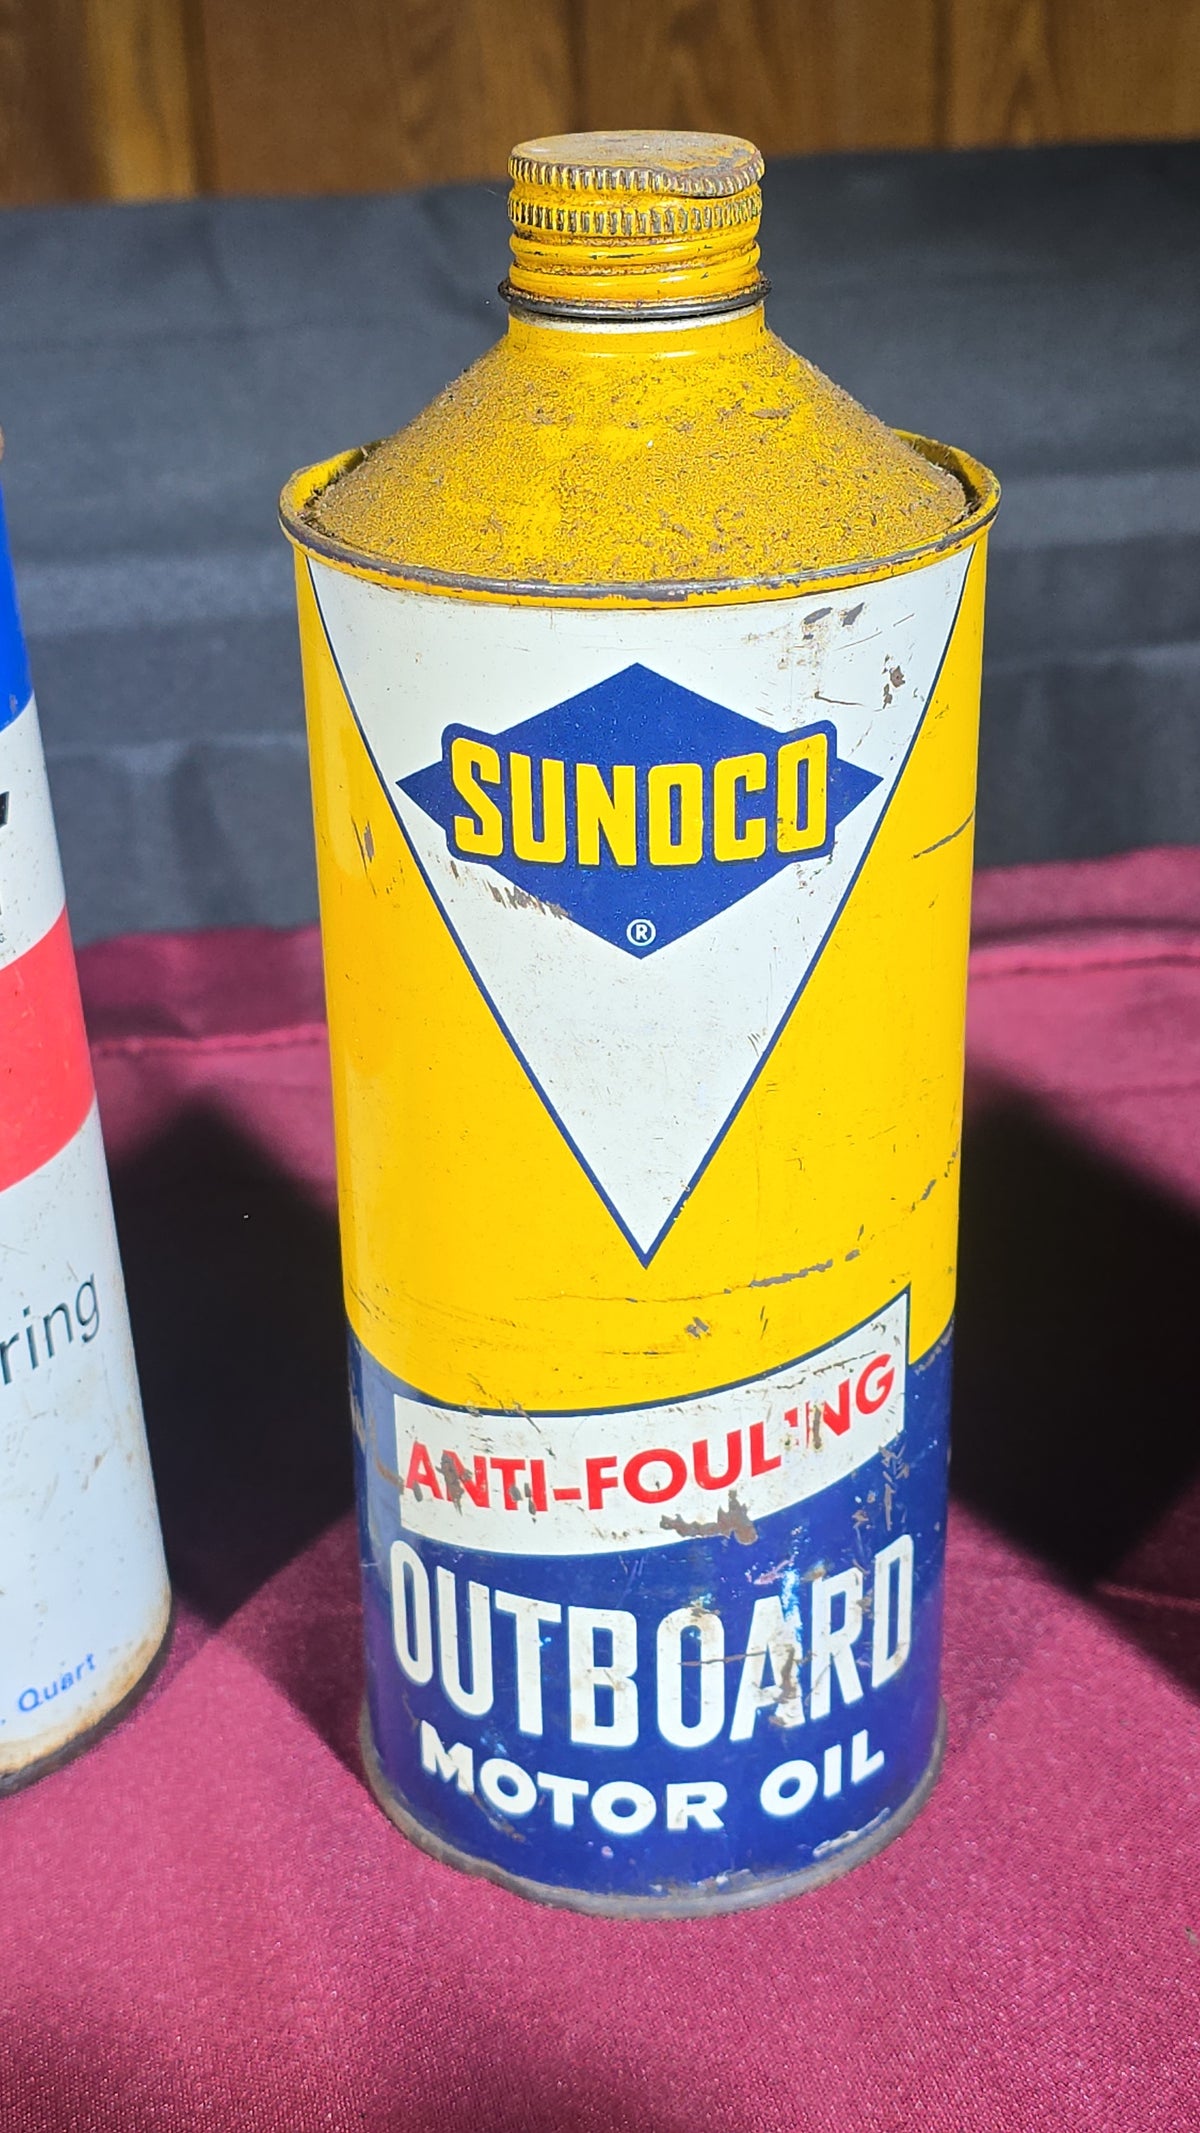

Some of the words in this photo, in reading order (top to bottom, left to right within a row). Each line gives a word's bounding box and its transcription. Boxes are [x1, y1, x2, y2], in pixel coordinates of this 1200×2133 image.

[451, 733, 829, 866] SUNOCO
[18, 1653, 95, 1712] Quart
[389, 1534, 914, 1749] OUTBOARD
[420, 1719, 728, 1835] MOTOR
[759, 1729, 886, 1817] OIL
